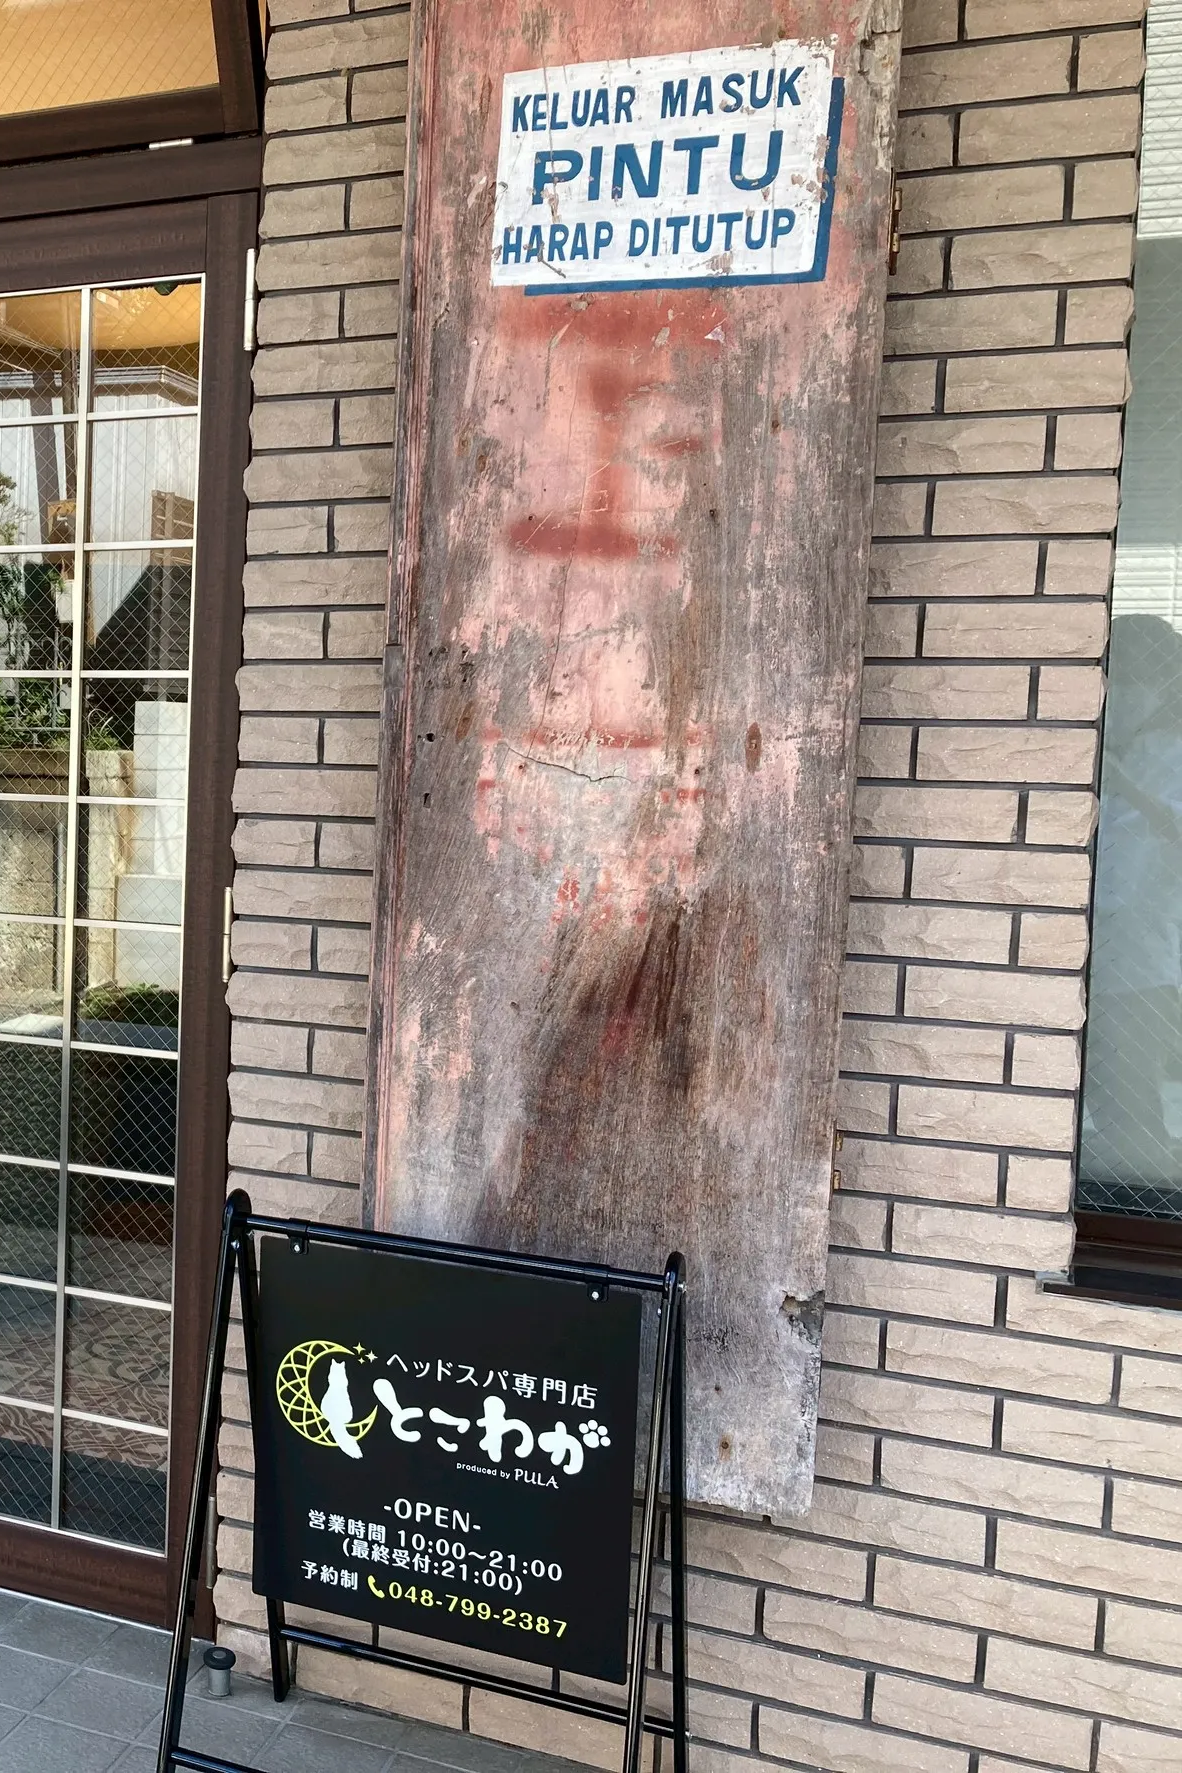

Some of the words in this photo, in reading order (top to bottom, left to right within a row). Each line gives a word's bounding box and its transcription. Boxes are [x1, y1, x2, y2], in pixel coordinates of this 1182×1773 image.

[512, 85, 636, 132] KELUAR
[660, 66, 805, 119] MASUK
[532, 130, 784, 206] PINTU
[501, 221, 614, 265] HARAP
[628, 208, 796, 257] DITUTUP
[386, 1353, 598, 1410] ヘッドスパ専門店
[372, 1378, 611, 1475] とこわが
[456, 1461, 498, 1477] produced
[500, 1469, 511, 1480] by
[514, 1468, 559, 1490] PULA
[308, 1508, 387, 1545] 営業時間
[300, 1560, 359, 1591] 予約制
[388, 1581, 567, 1639] 048-799-2387
